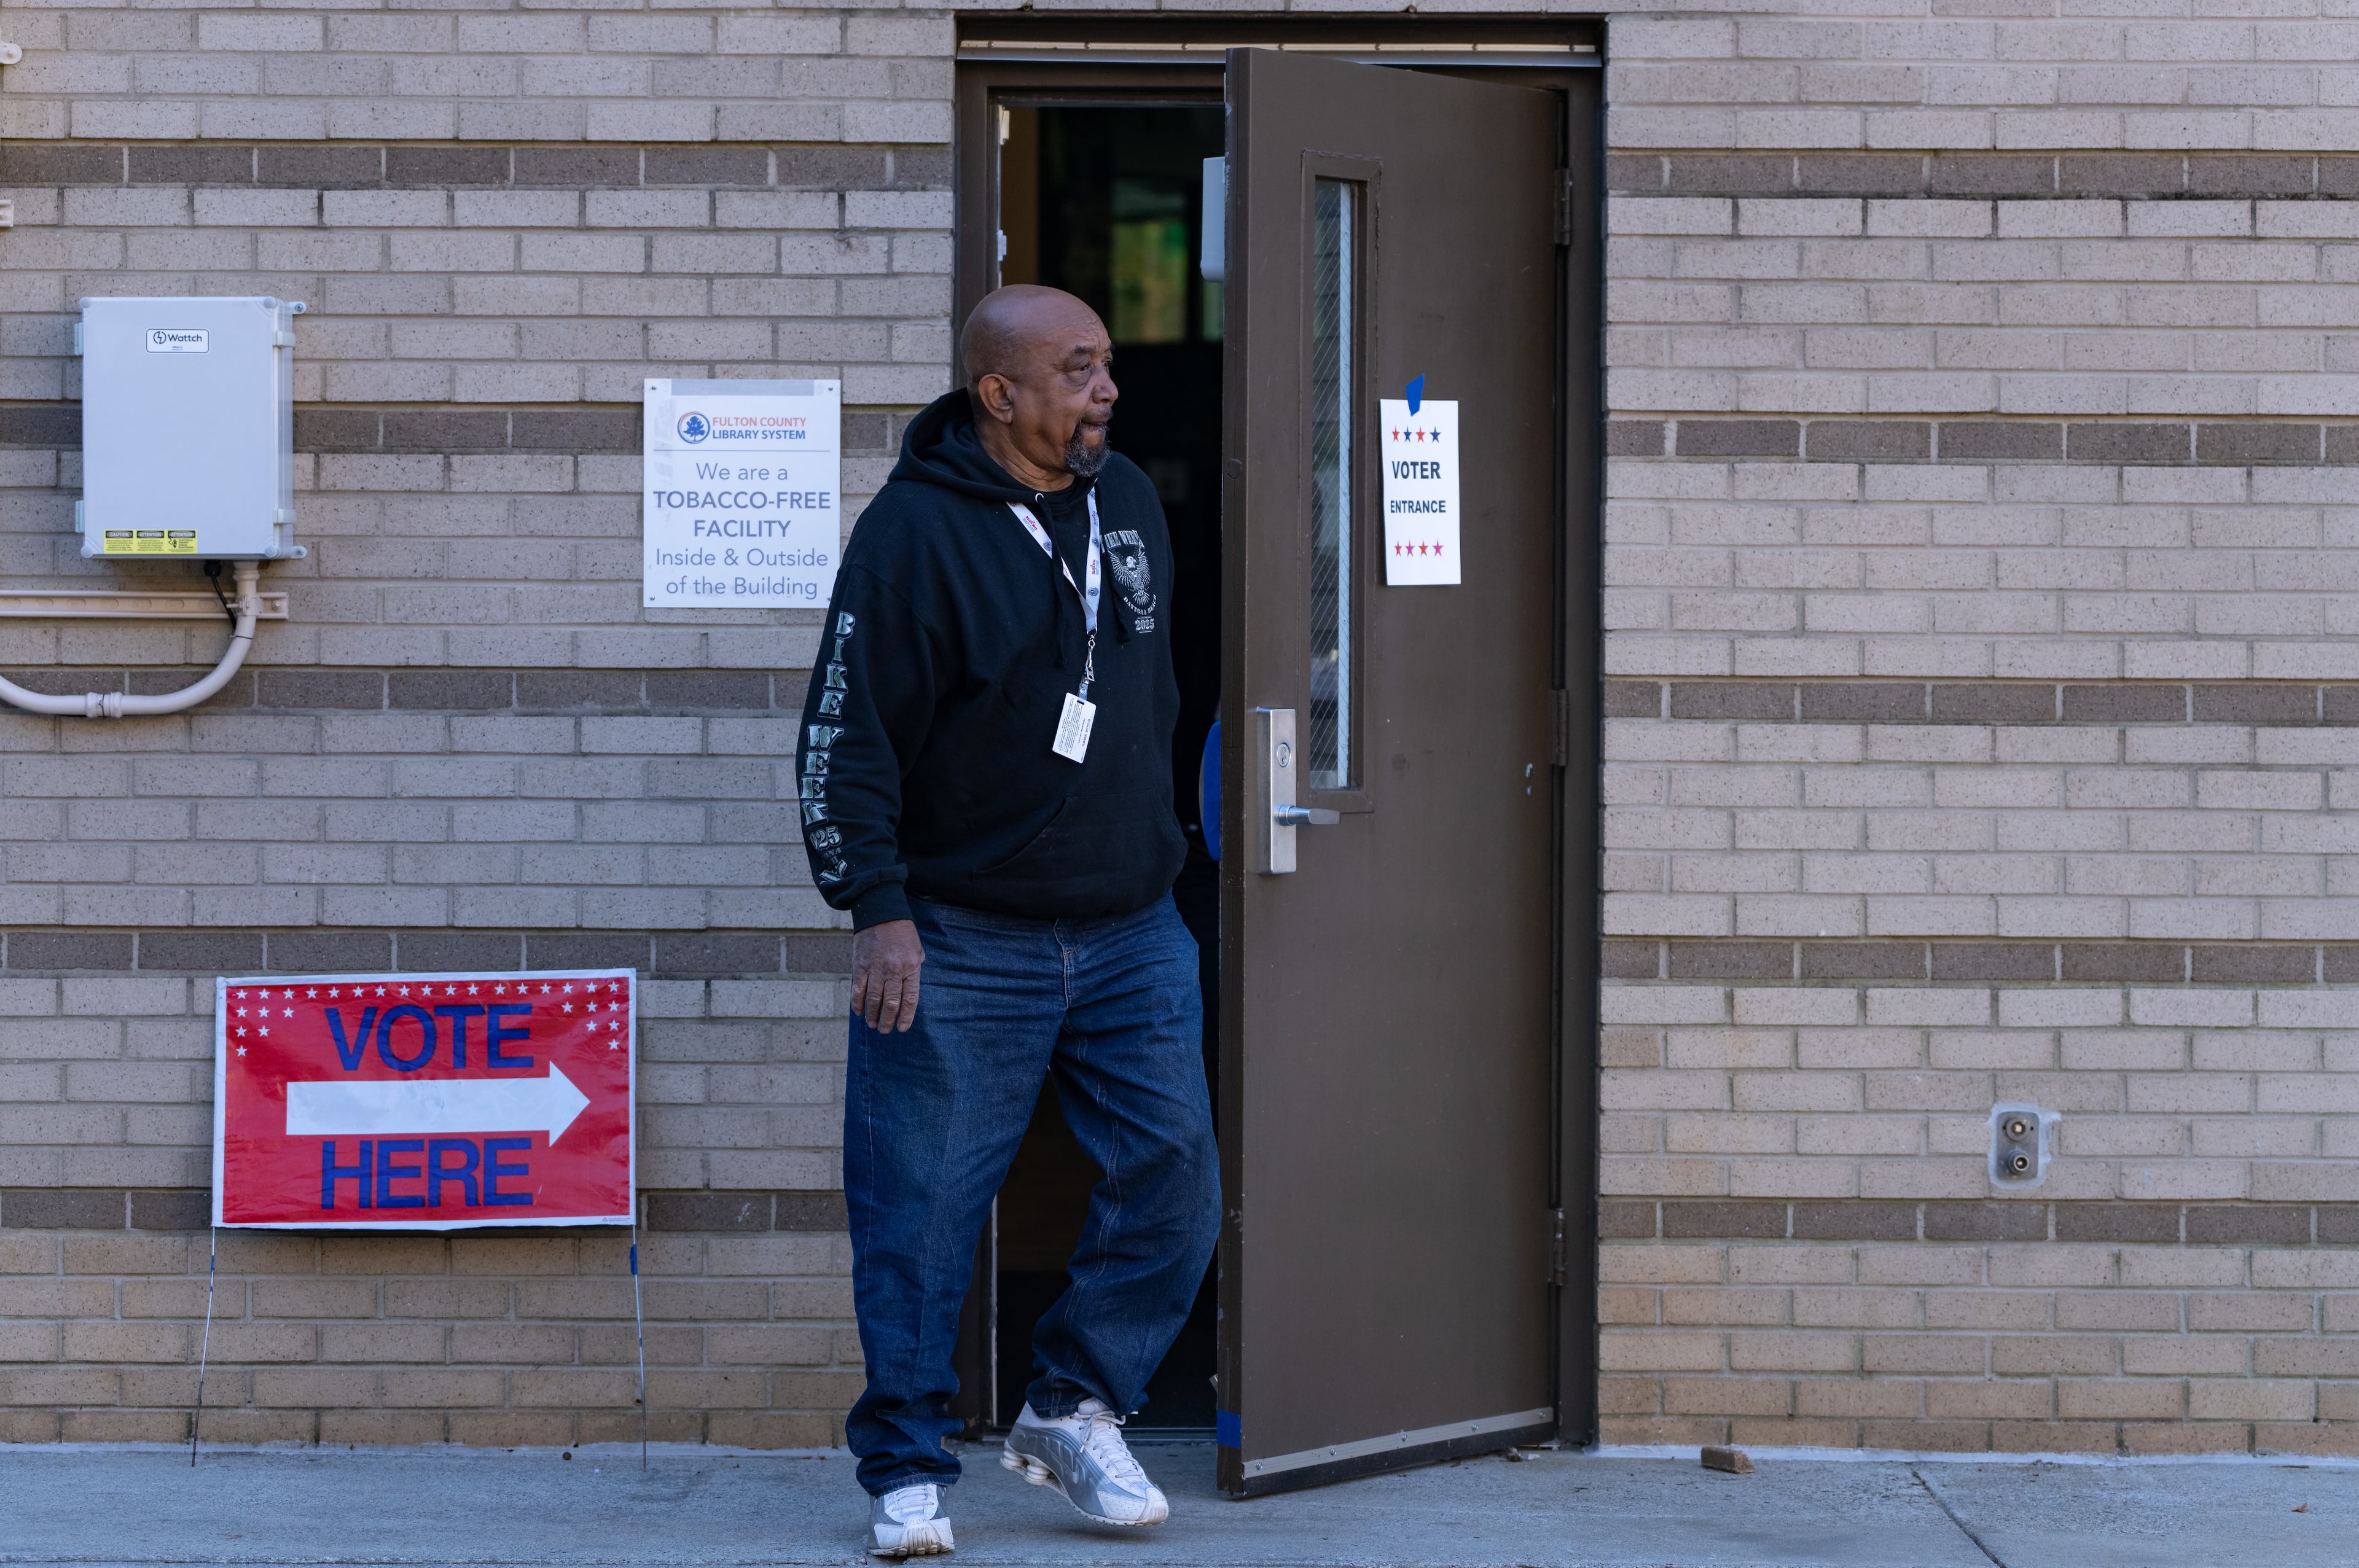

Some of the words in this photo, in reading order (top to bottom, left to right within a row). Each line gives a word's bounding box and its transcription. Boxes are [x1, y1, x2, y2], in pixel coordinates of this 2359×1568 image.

[168, 333, 202, 342] Wattch
[713, 417, 757, 427] FULTON
[760, 417, 807, 427] COUNTY
[713, 430, 759, 439] LIBRARY
[761, 430, 806, 440] SYSTEM
[696, 462, 730, 480] We
[738, 467, 770, 480] are
[777, 467, 788, 480] a
[1391, 461, 1441, 479] VOTER
[653, 491, 831, 509] TOBACCO-FREE
[1390, 500, 1446, 513] ENTRANCE
[694, 520, 792, 537] FACILITY
[656, 547, 716, 566] Inside
[724, 548, 739, 566] &
[746, 548, 828, 566] Outside
[666, 575, 687, 595] of
[693, 575, 726, 595] the
[734, 576, 818, 599] Building
[1123, 596, 1147, 615] DAYTONA
[1135, 618, 1154, 631] 2025
[818, 611, 856, 720] BIKE
[800, 725, 844, 828] WEEK
[324, 1002, 534, 1072] VOTE
[321, 1136, 533, 1211] HERE
